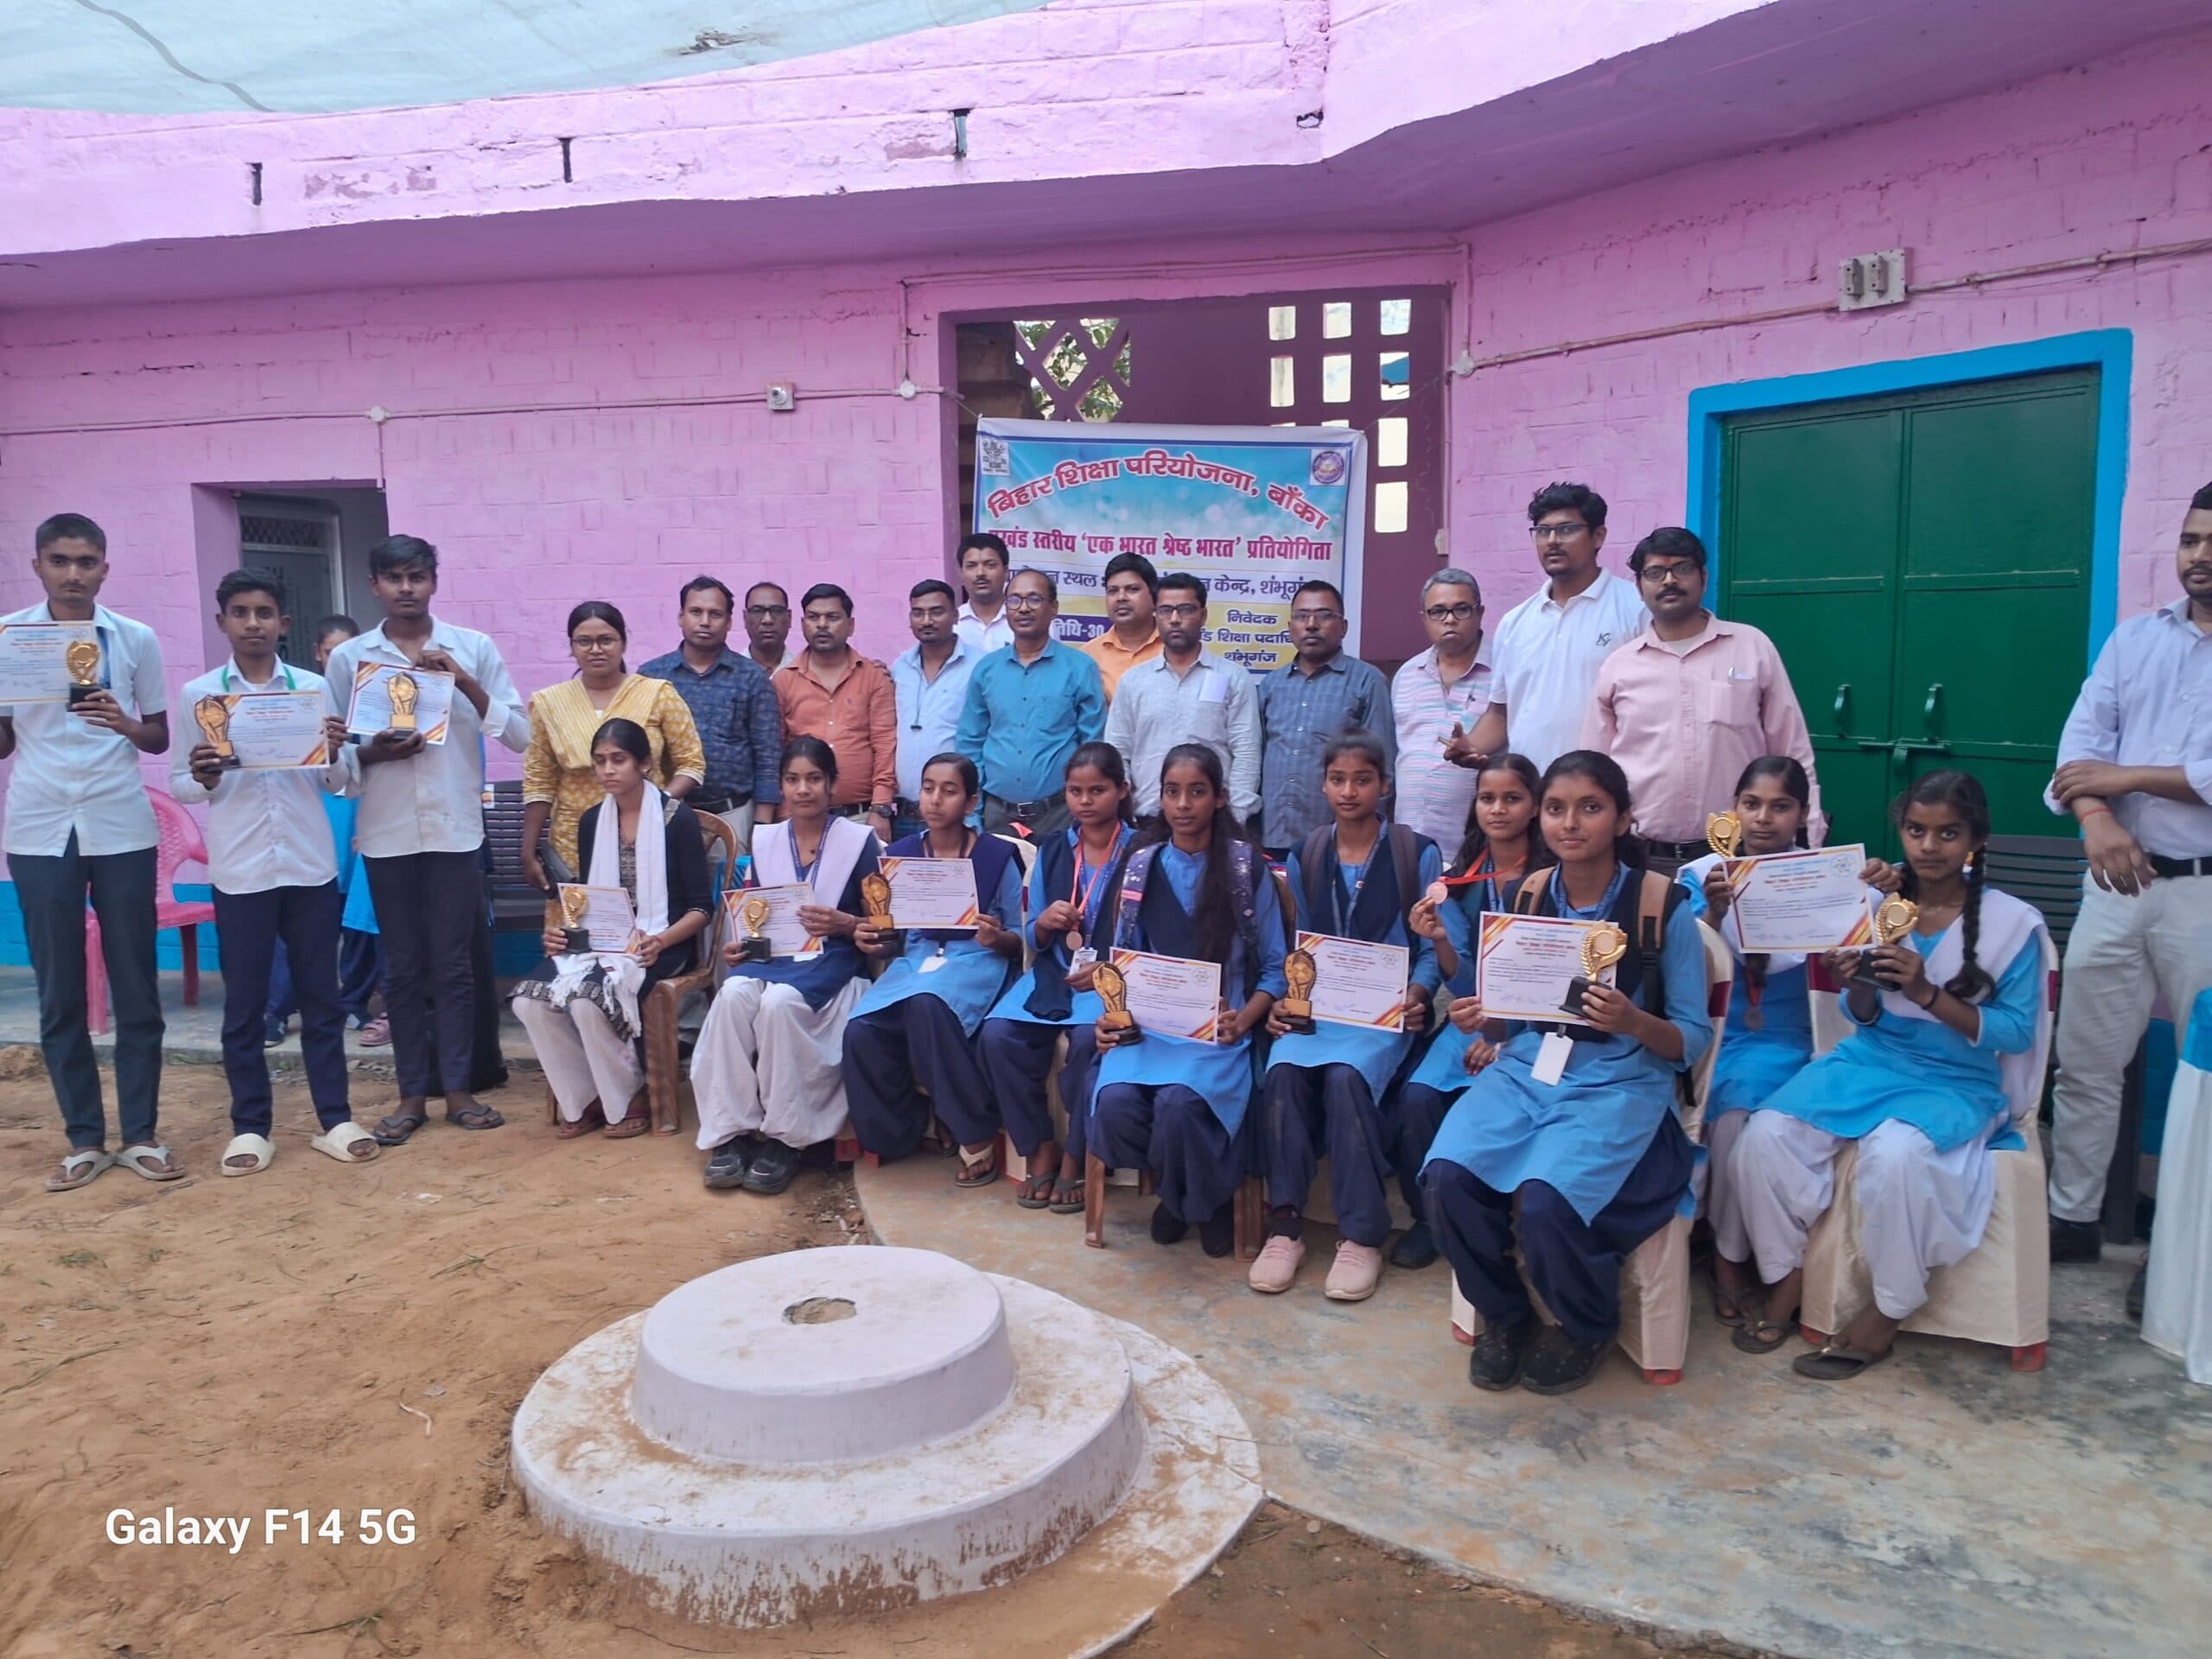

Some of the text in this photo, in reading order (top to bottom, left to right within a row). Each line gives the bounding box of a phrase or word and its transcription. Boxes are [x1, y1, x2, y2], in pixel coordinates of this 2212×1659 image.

[987, 450, 1329, 531] बिहार शिक्षा परियोजना, बाँका
[1033, 529, 1076, 552] स्तरीय
[1119, 537, 1158, 556] भारत
[1247, 536, 1333, 561] प्रतियोगिता
[1063, 571, 1099, 588] स्थल
[1260, 575, 1307, 600] शंभूगं
[1227, 609, 1279, 625] निवेदक
[1217, 627, 1250, 644] शिक्षा
[1224, 649, 1277, 667] शंभूगंज
